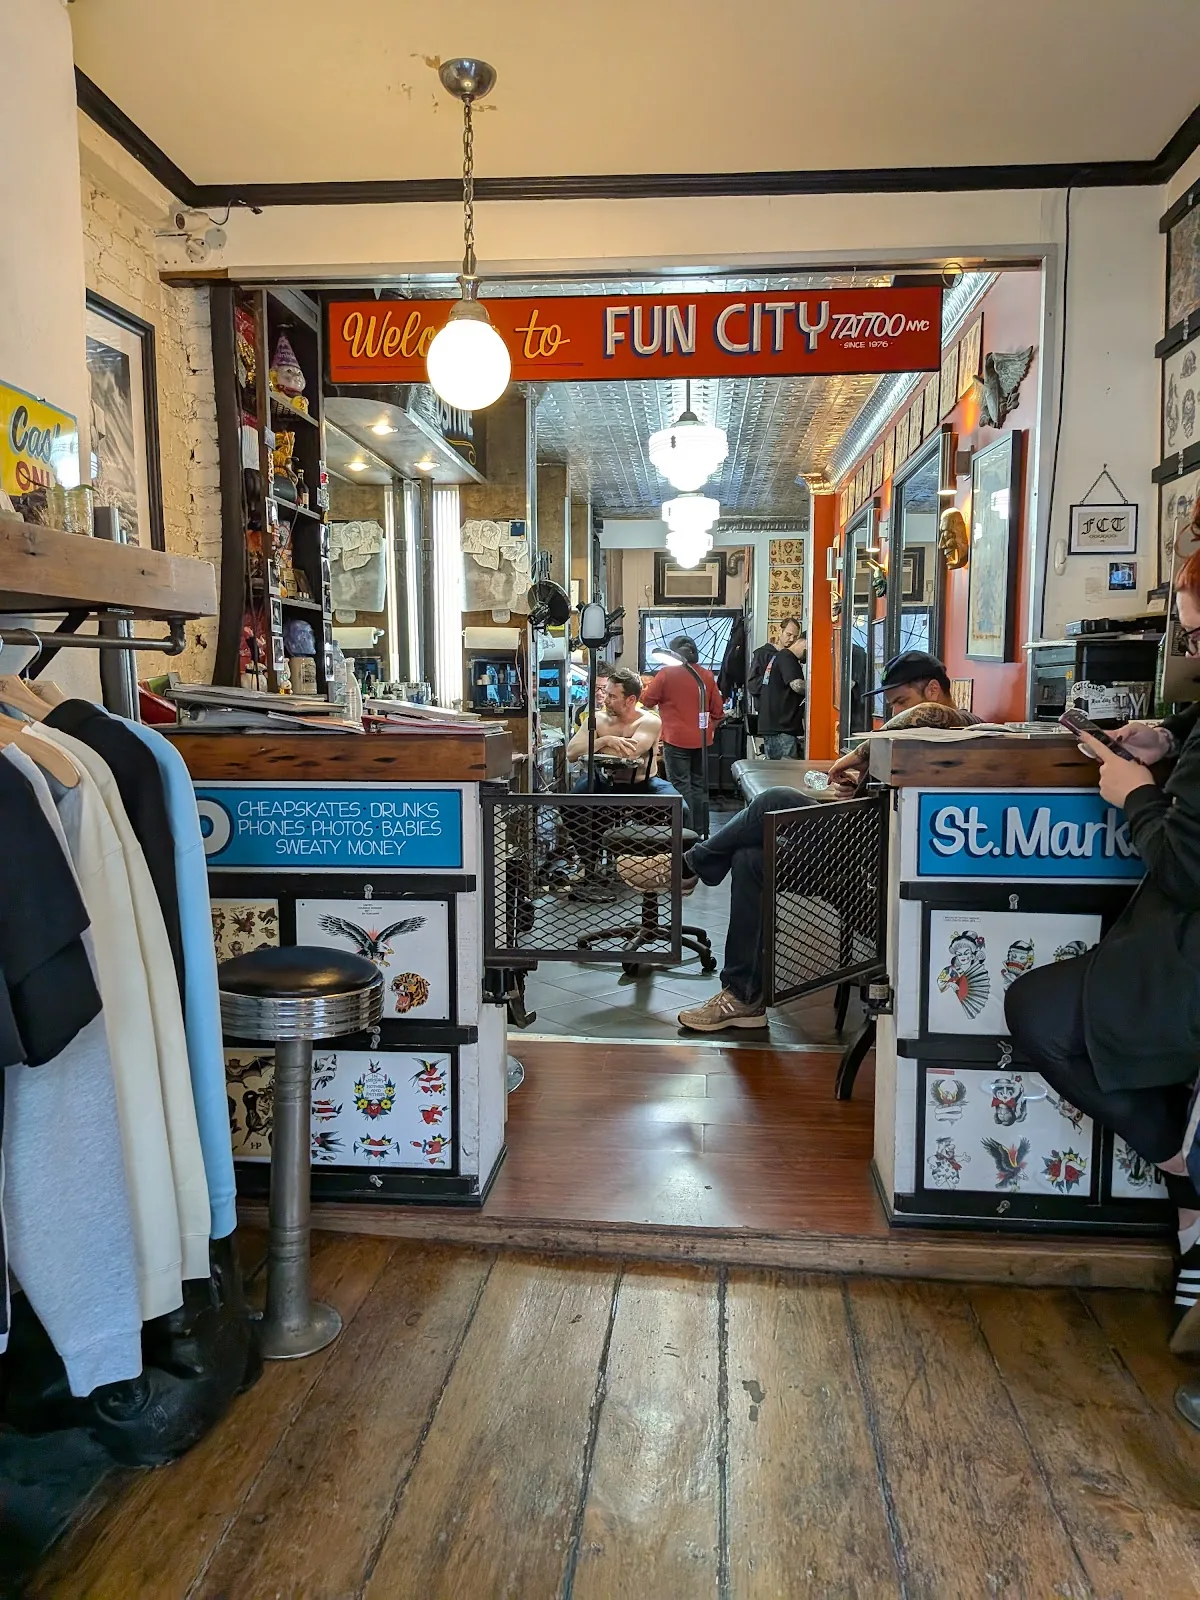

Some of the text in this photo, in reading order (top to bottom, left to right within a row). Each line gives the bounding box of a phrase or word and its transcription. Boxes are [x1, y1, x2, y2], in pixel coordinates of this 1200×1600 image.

[343, 301, 930, 359] Welc to FUN CITY TATTOO NYC
[844, 340, 889, 349] SINCE 1976
[1081, 516, 1126, 535] FCT
[237, 801, 440, 818] CHEAPSKATES DRUNKS
[238, 820, 442, 837] PHONES PHOTOS BABIES
[275, 839, 406, 855] SWEATY MONEY
